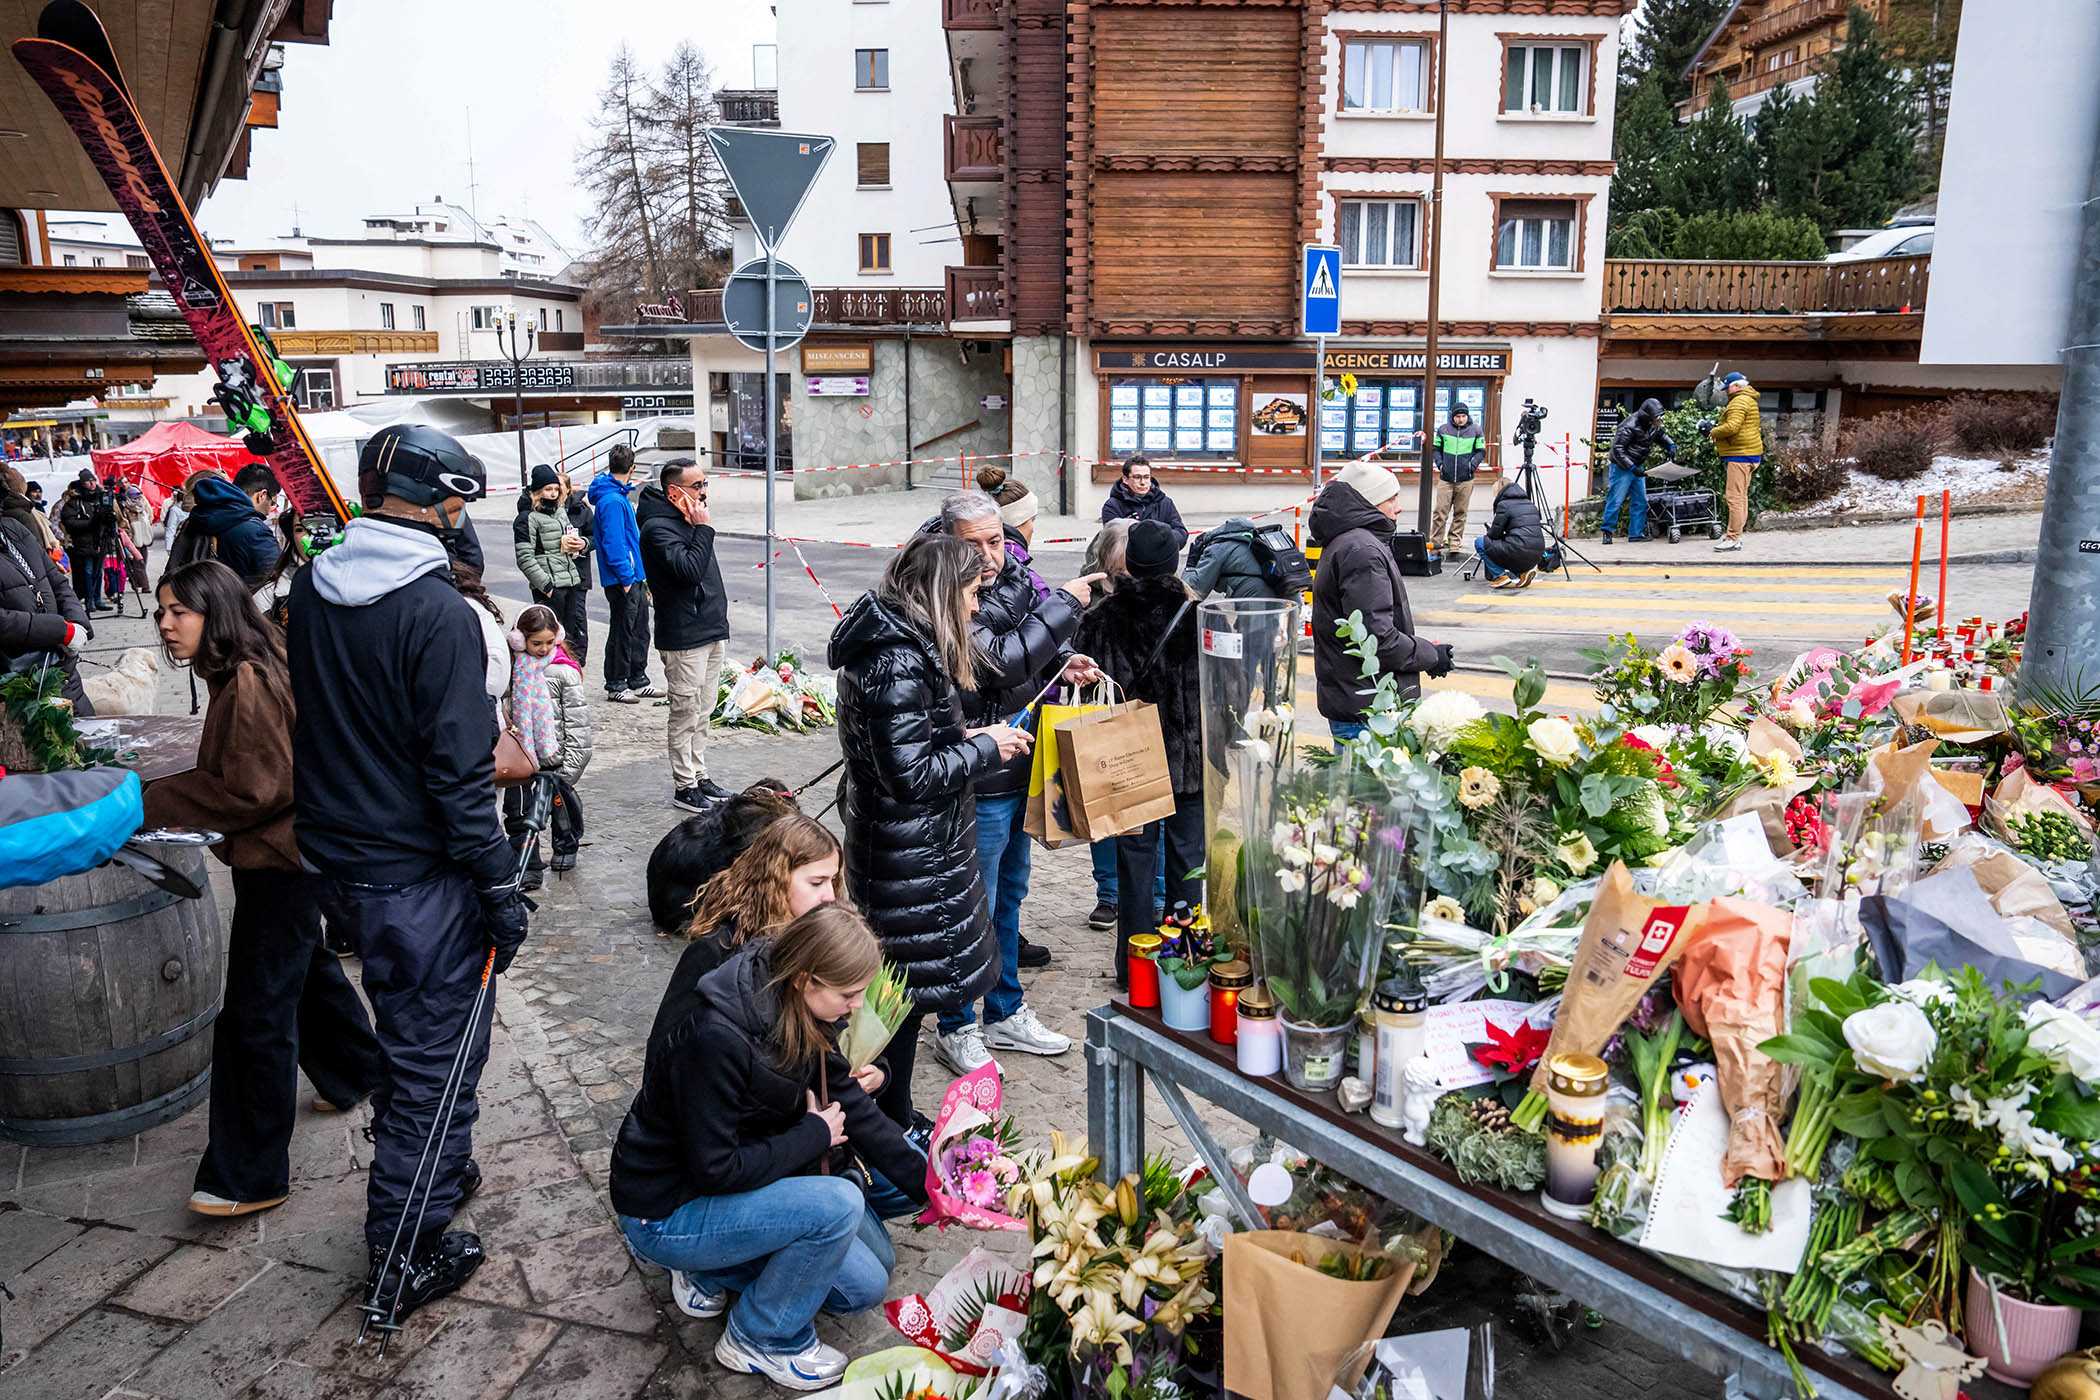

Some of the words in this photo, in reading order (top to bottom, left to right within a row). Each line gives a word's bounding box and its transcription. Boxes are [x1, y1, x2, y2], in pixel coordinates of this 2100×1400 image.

[52, 67, 160, 213] NORDICA
[1154, 353, 1226, 367] CASALP
[1324, 354, 1389, 368] AGENCE
[1392, 354, 1500, 368] IMMBILIERE
[428, 370, 456, 381] rental
